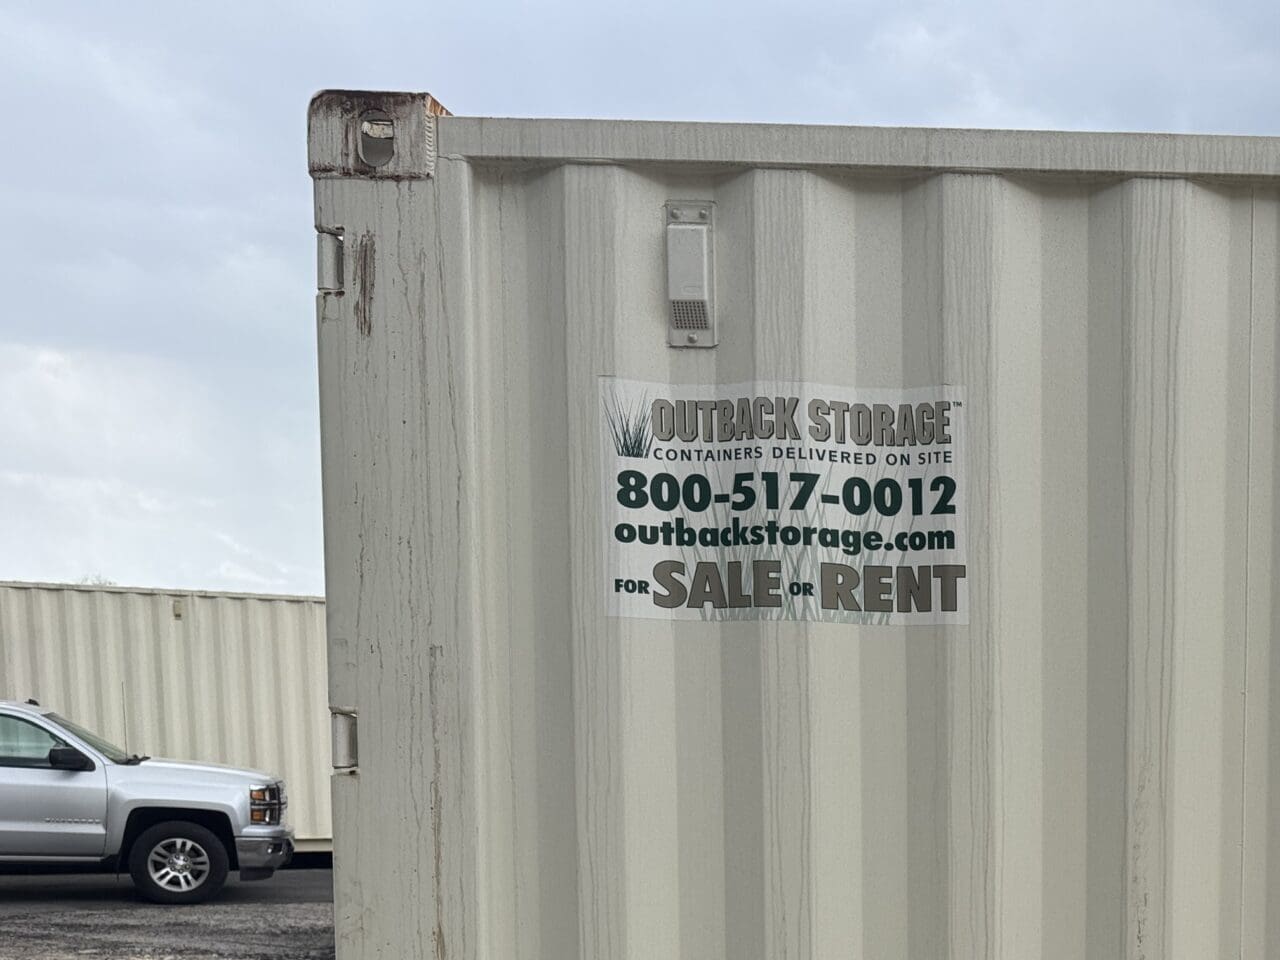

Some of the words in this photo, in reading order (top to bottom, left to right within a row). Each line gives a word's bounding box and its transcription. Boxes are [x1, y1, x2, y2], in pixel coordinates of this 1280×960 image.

[651, 397, 800, 443] OUTBACK
[808, 399, 952, 447] STORAGE
[653, 447, 763, 462] CONTAINERS
[773, 447, 877, 465] DELIVERED
[886, 452, 911, 466] ON
[918, 451, 953, 465] SITE
[616, 470, 957, 517] 800-517-0012
[614, 517, 956, 555] outbackstorage.com
[614, 579, 650, 595] FOR
[652, 560, 782, 609] SALE
[789, 582, 814, 596] OR
[820, 562, 966, 613] RENT
